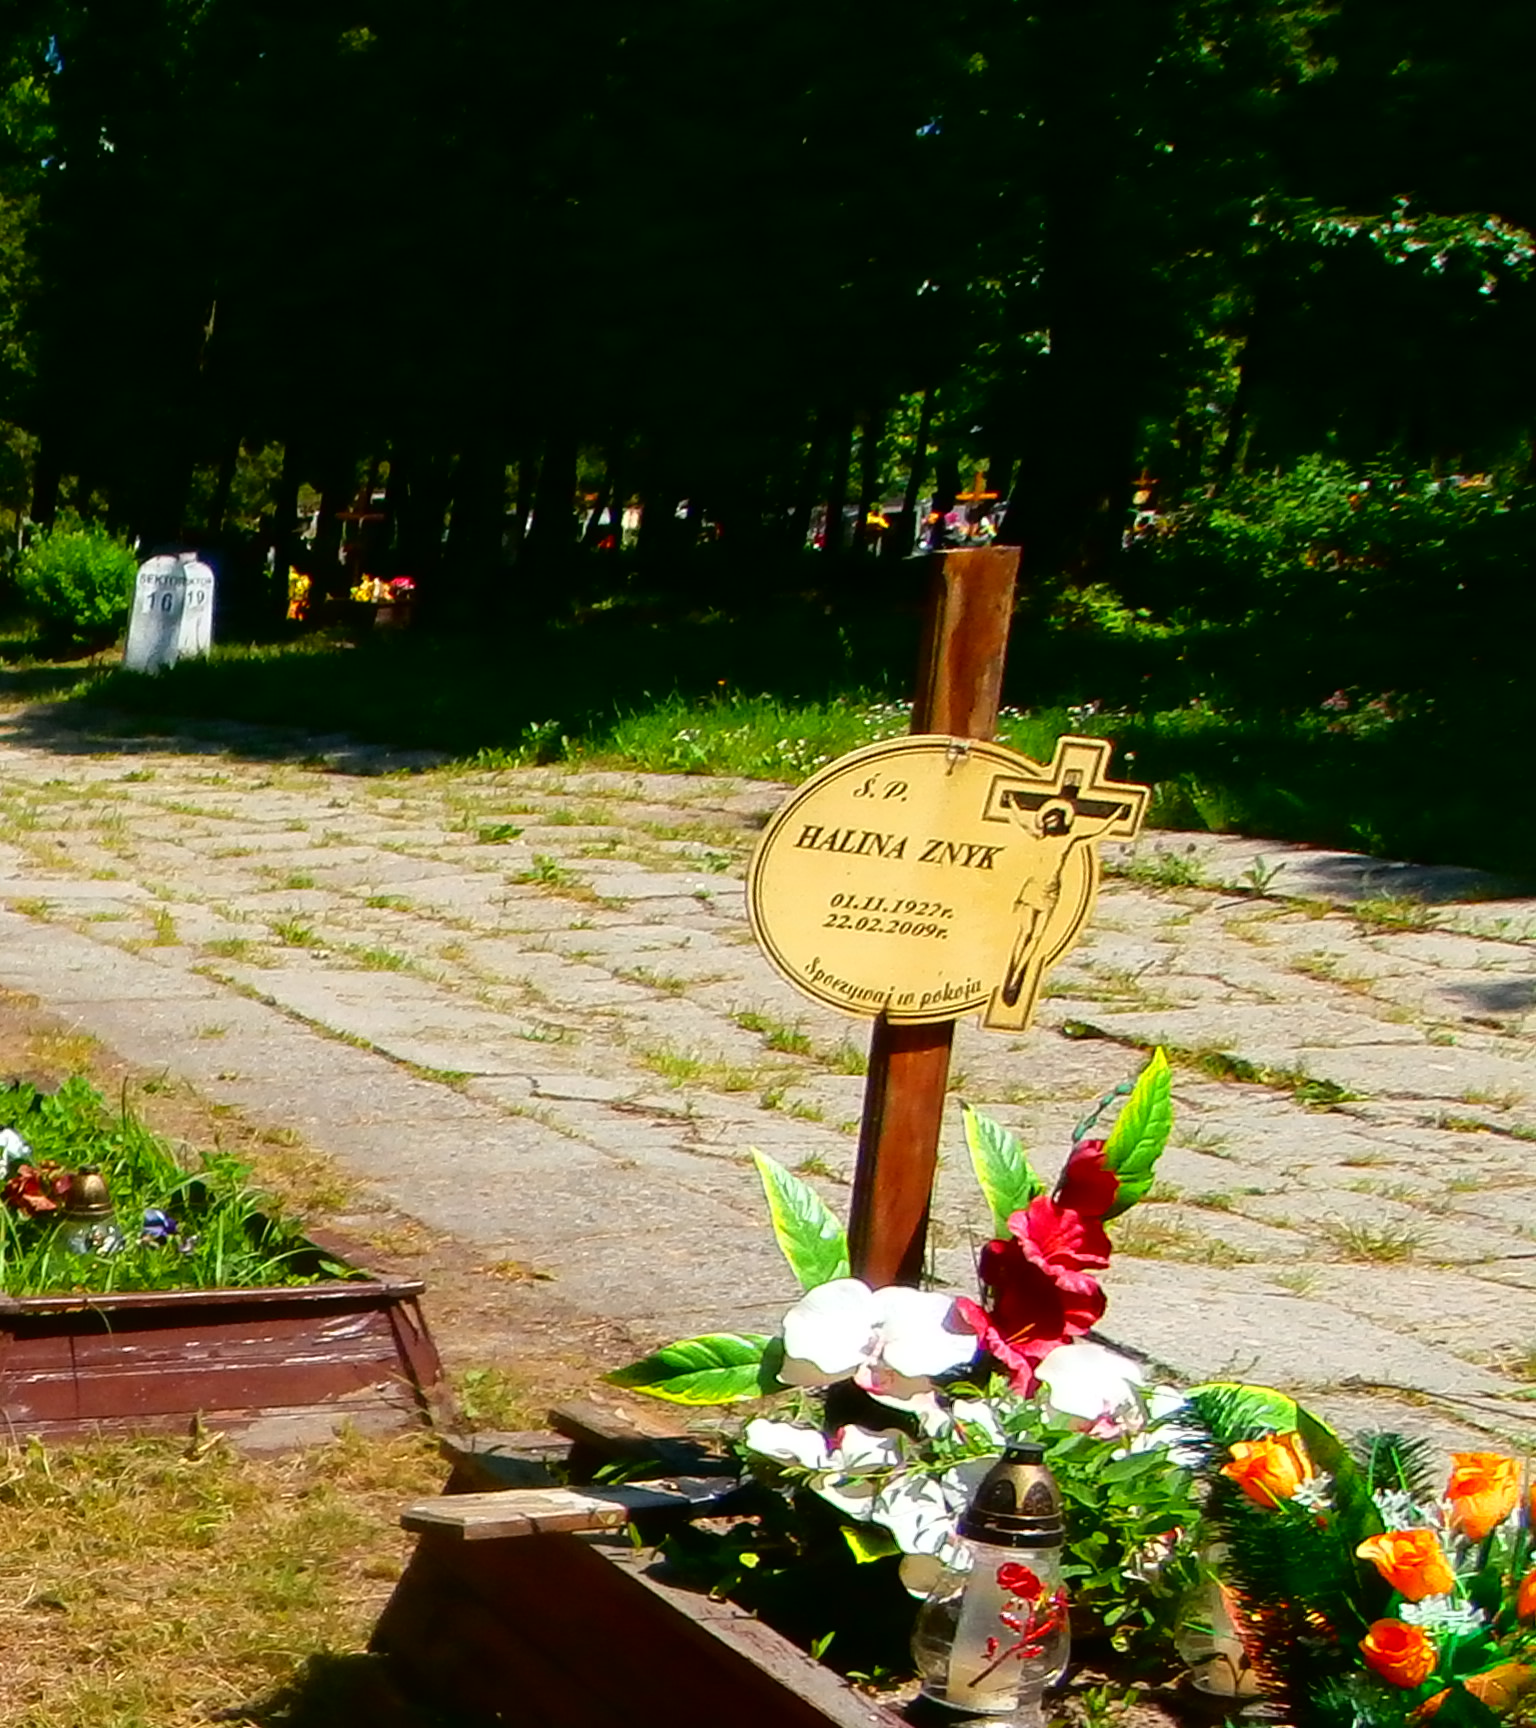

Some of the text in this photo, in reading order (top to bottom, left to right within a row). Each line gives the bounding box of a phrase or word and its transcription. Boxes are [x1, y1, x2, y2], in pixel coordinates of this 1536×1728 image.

[793, 825, 1007, 870] HALINA ZNYK
[830, 892, 955, 919] 01.11.1927r.
[822, 913, 949, 940] 22.02.2009r.
[919, 977, 981, 1009] pokoju
